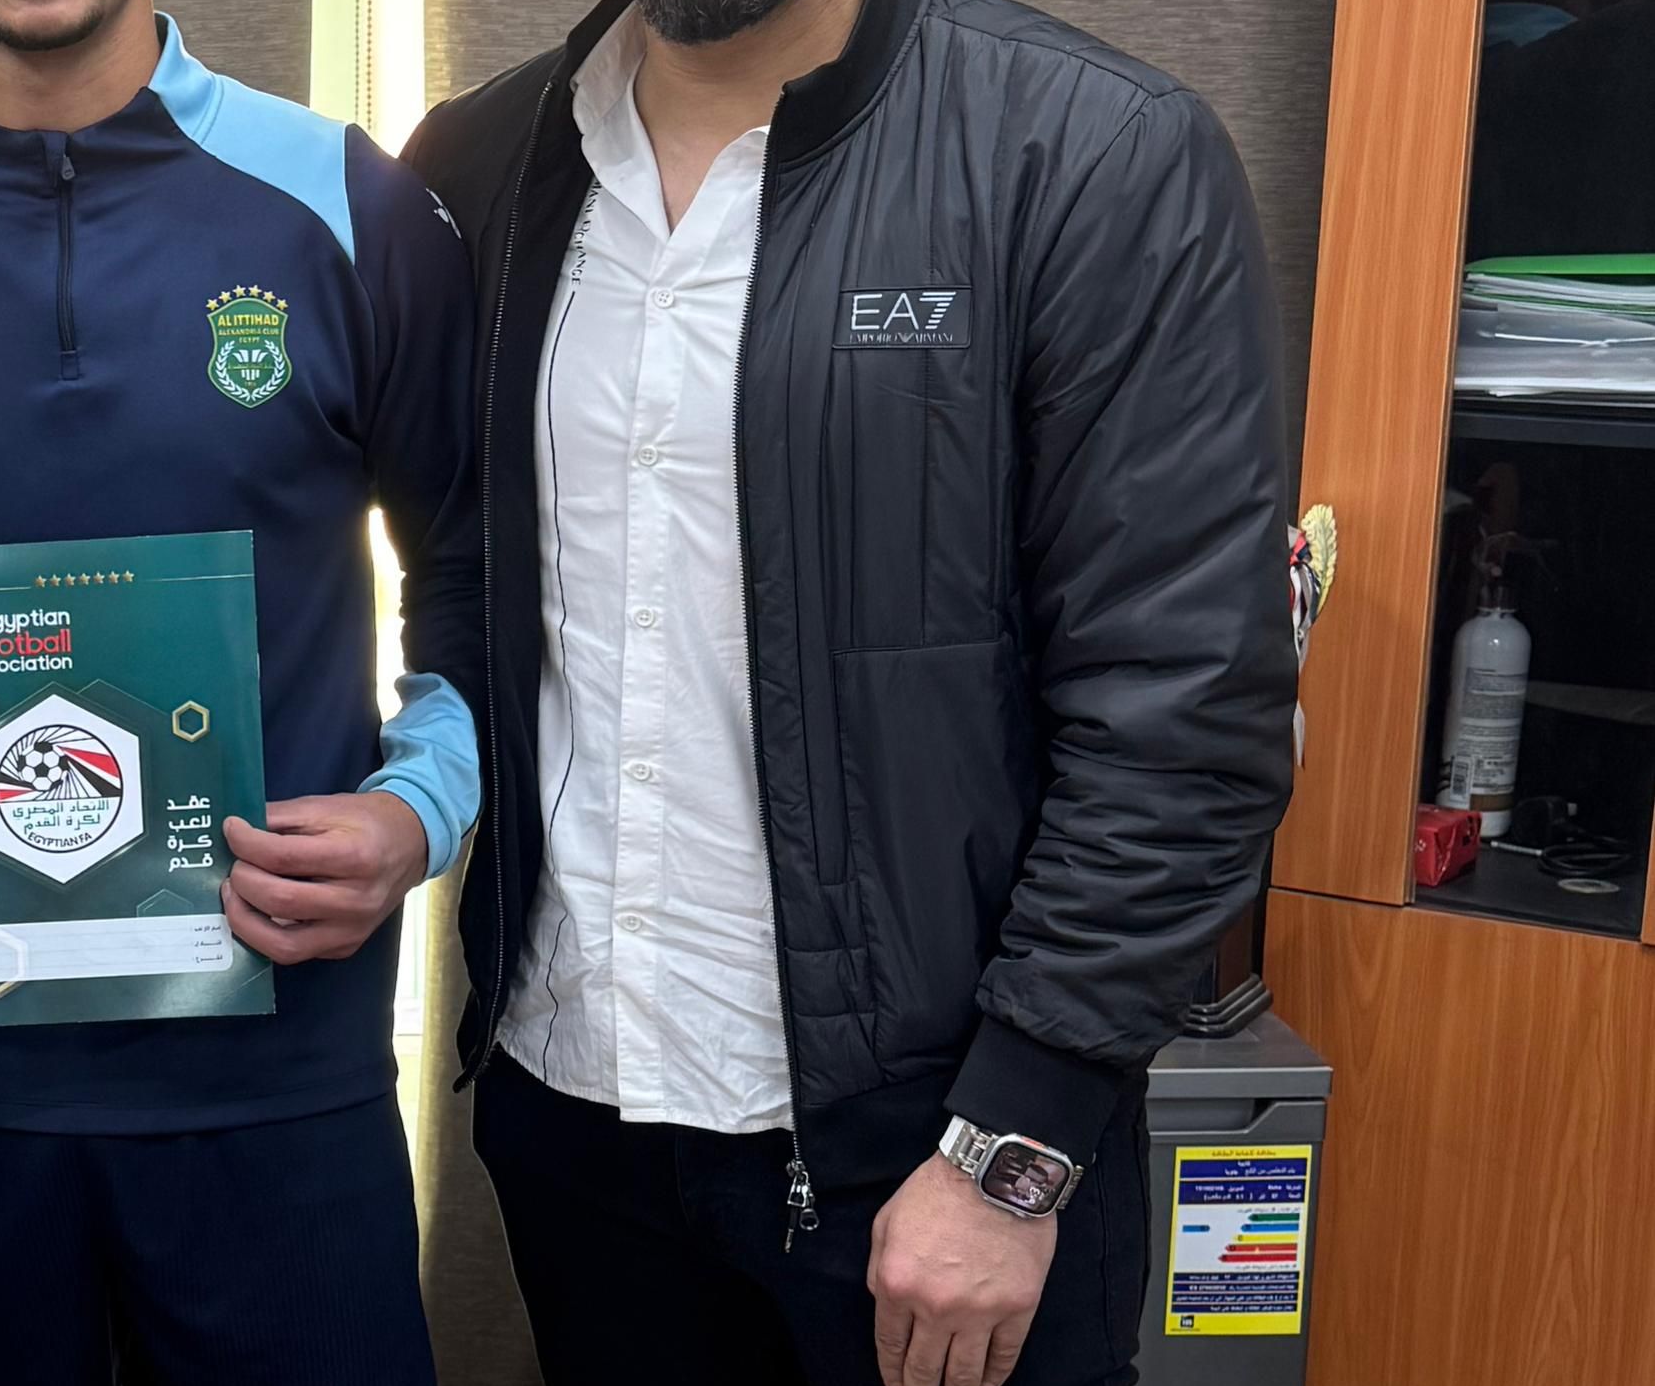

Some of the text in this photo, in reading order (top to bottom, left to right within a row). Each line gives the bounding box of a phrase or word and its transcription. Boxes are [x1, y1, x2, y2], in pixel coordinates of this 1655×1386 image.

[218, 314, 279, 326] AL ITTIHAD
[850, 291, 957, 331] EA7
[70, 800, 110, 813] الاتحاد
[24, 813, 101, 835] لكرة القدم
[28, 832, 93, 847] EGYPTIAN FA
[167, 834, 213, 852] كرة
[168, 853, 213, 872] قدم
